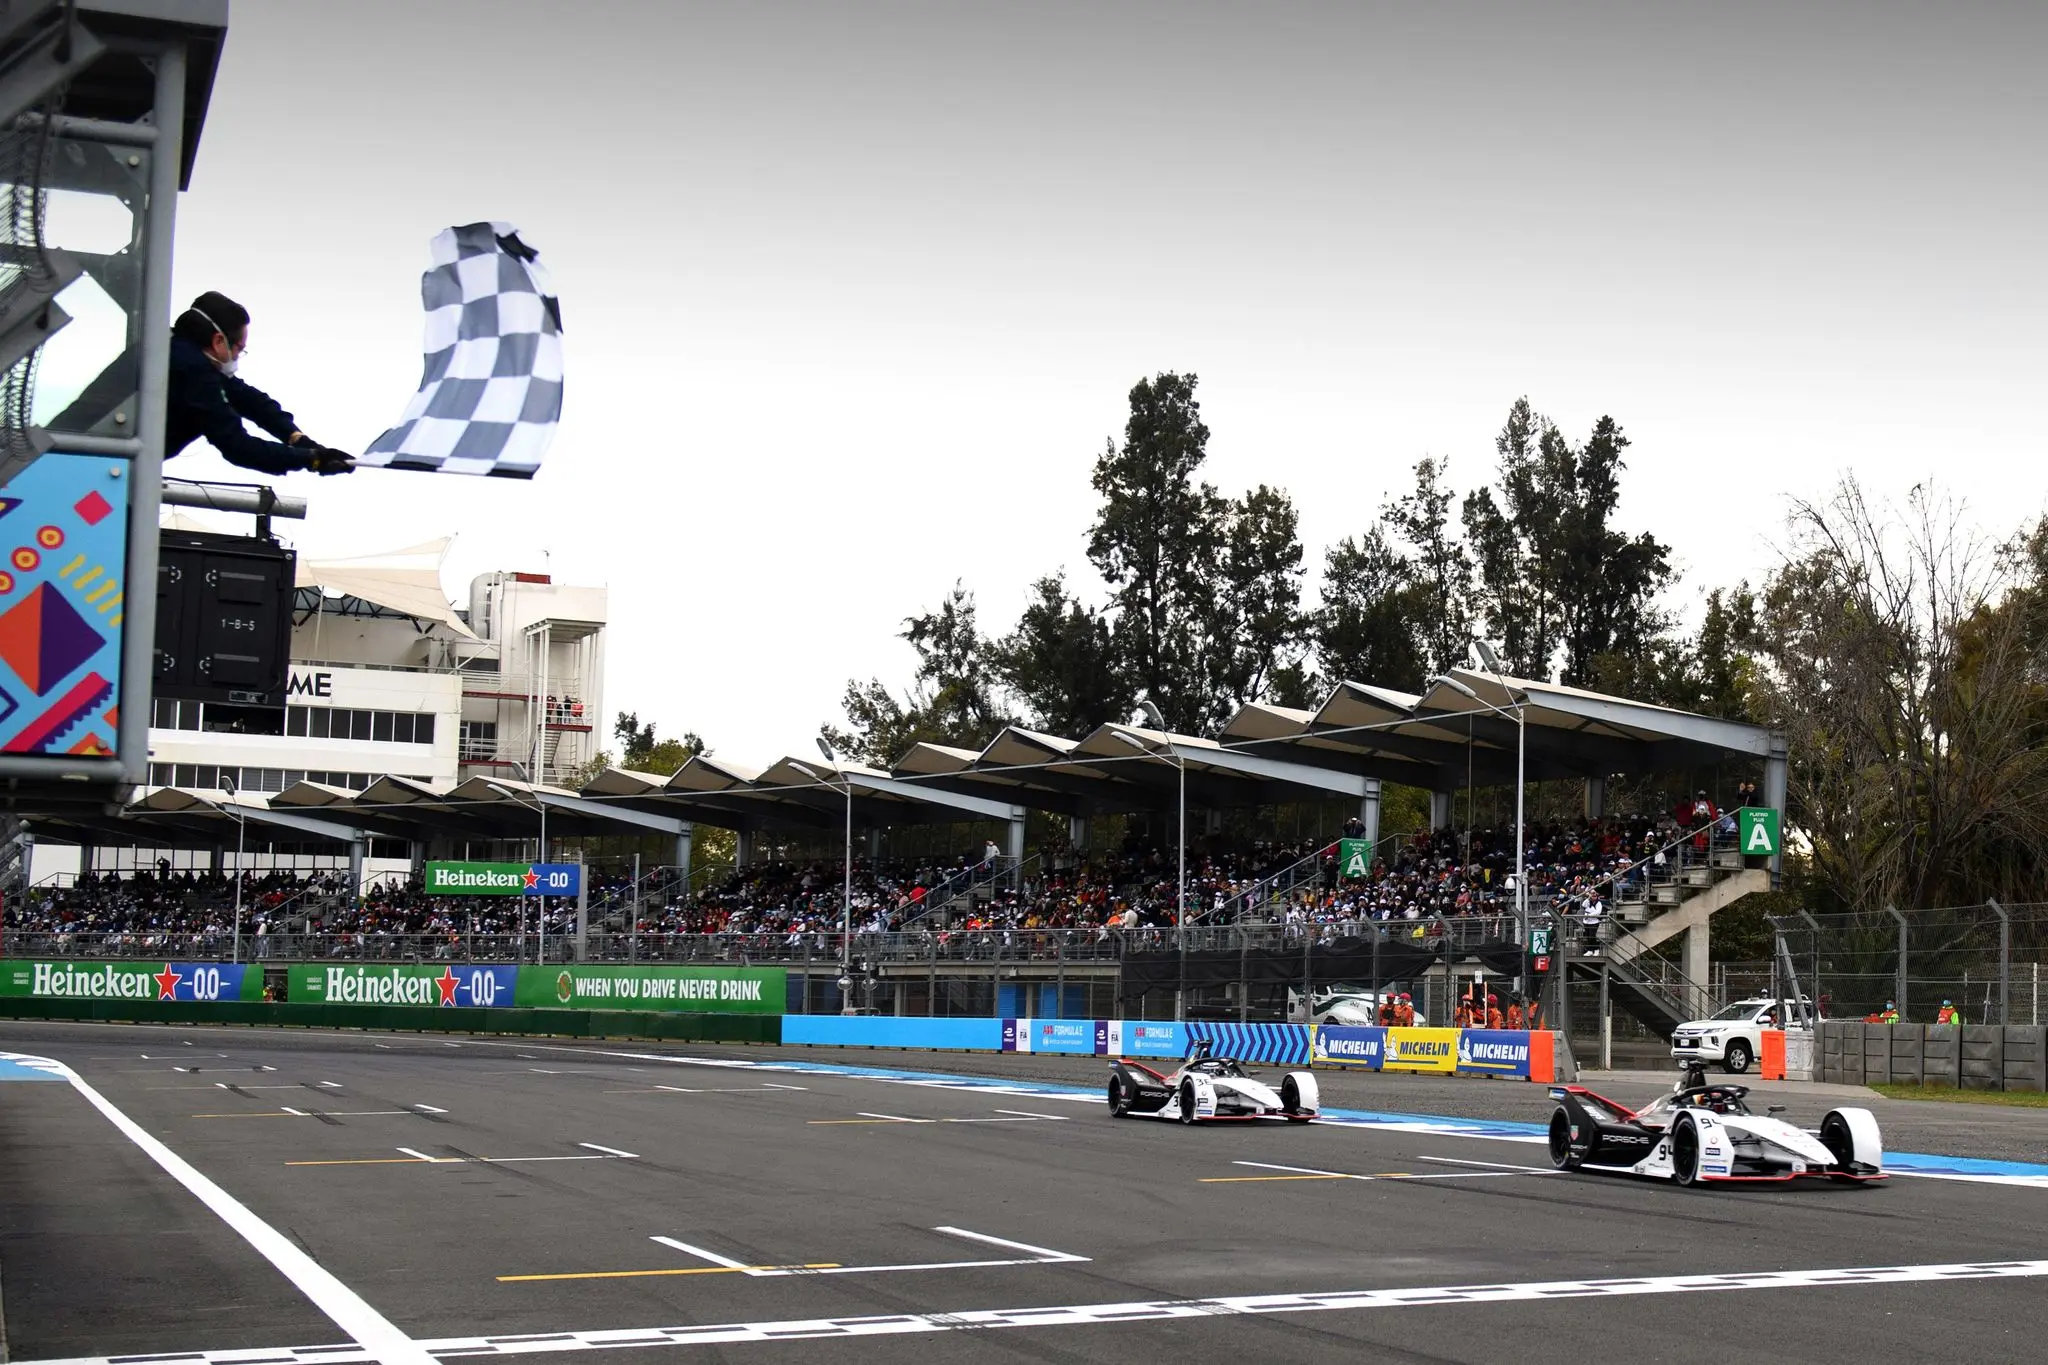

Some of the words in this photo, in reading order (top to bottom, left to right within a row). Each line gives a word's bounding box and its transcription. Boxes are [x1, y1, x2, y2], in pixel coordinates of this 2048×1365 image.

[1747, 823, 1772, 850] A
[1346, 852, 1366, 874] A
[434, 868, 520, 886] Heineken
[550, 872, 568, 888] 0.0
[32, 964, 152, 998] Heineken
[194, 967, 219, 1000] 0.0
[325, 967, 433, 1004] Heineken
[472, 970, 495, 1006] 0.0
[576, 978, 611, 997] WHEN
[614, 978, 640, 998] YOU
[642, 979, 676, 999] DRIVE
[679, 980, 718, 1000] NEVER
[720, 980, 762, 1001] DRINK
[1054, 1026, 1078, 1036] FORMULA
[1146, 1028, 1168, 1038] FORMULA
[1328, 1040, 1378, 1056] MICHELIN
[1400, 1042, 1450, 1056] MICHELIN
[1472, 1043, 1528, 1060] MICHELIN
[1602, 1134, 1649, 1144] PORSCHE
